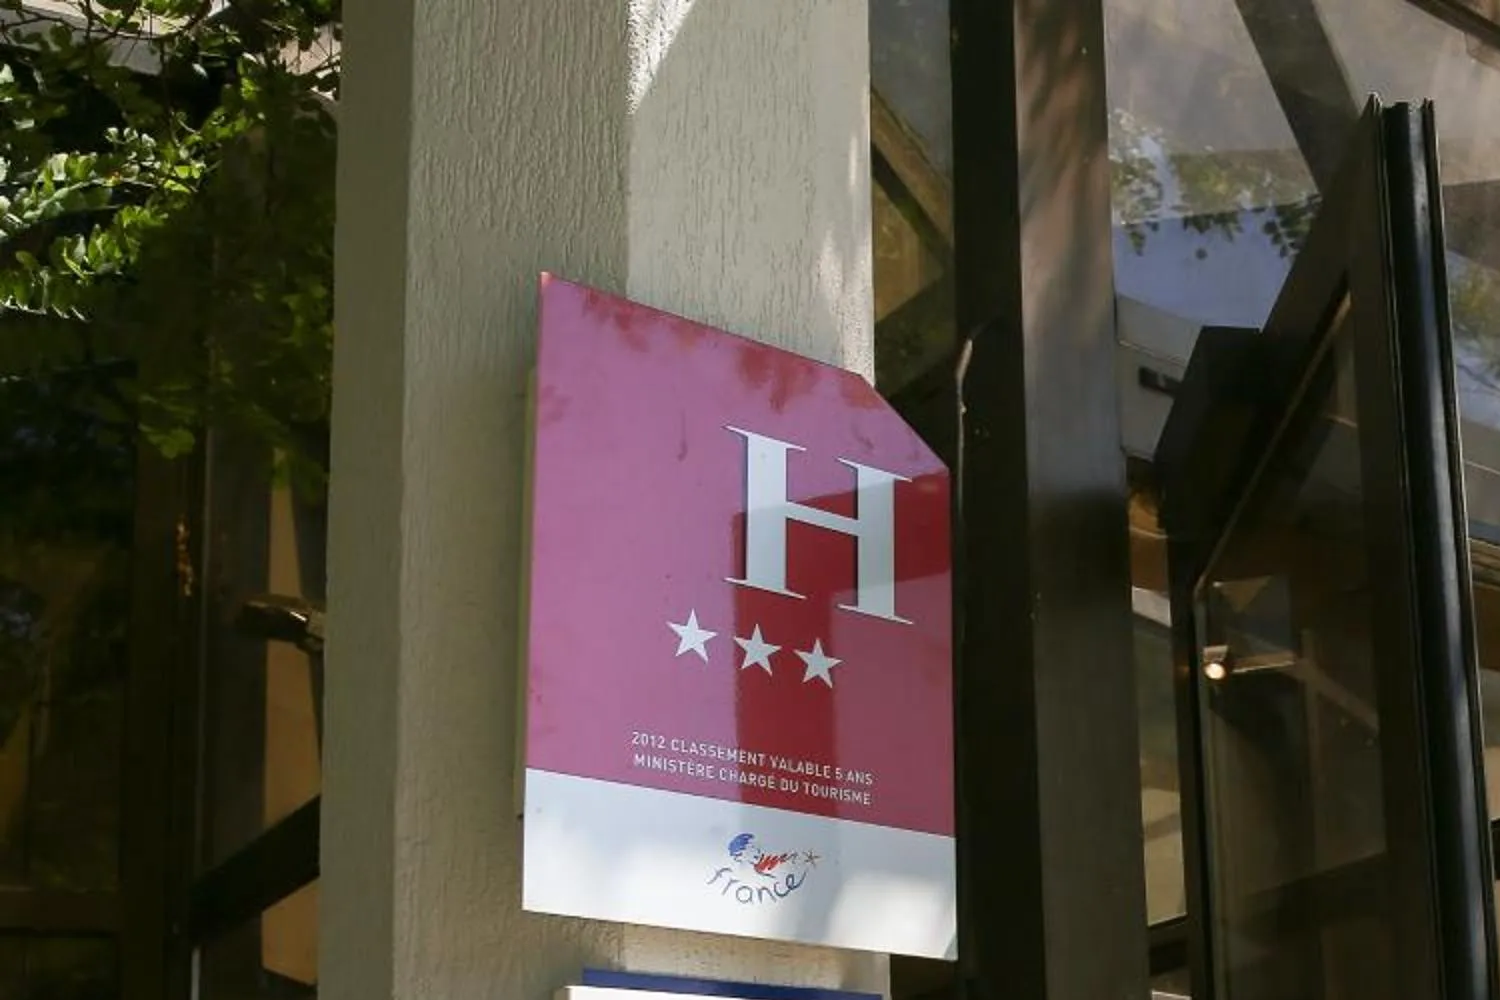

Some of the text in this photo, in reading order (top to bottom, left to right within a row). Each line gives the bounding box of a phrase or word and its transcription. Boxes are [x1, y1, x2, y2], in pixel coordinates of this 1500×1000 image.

[723, 425, 912, 625] H
[631, 730, 873, 786] 2012 CLASSEMENT VALABLE 5 ANS
[780, 778, 799, 794] DU
[802, 781, 872, 806] TOURISME
